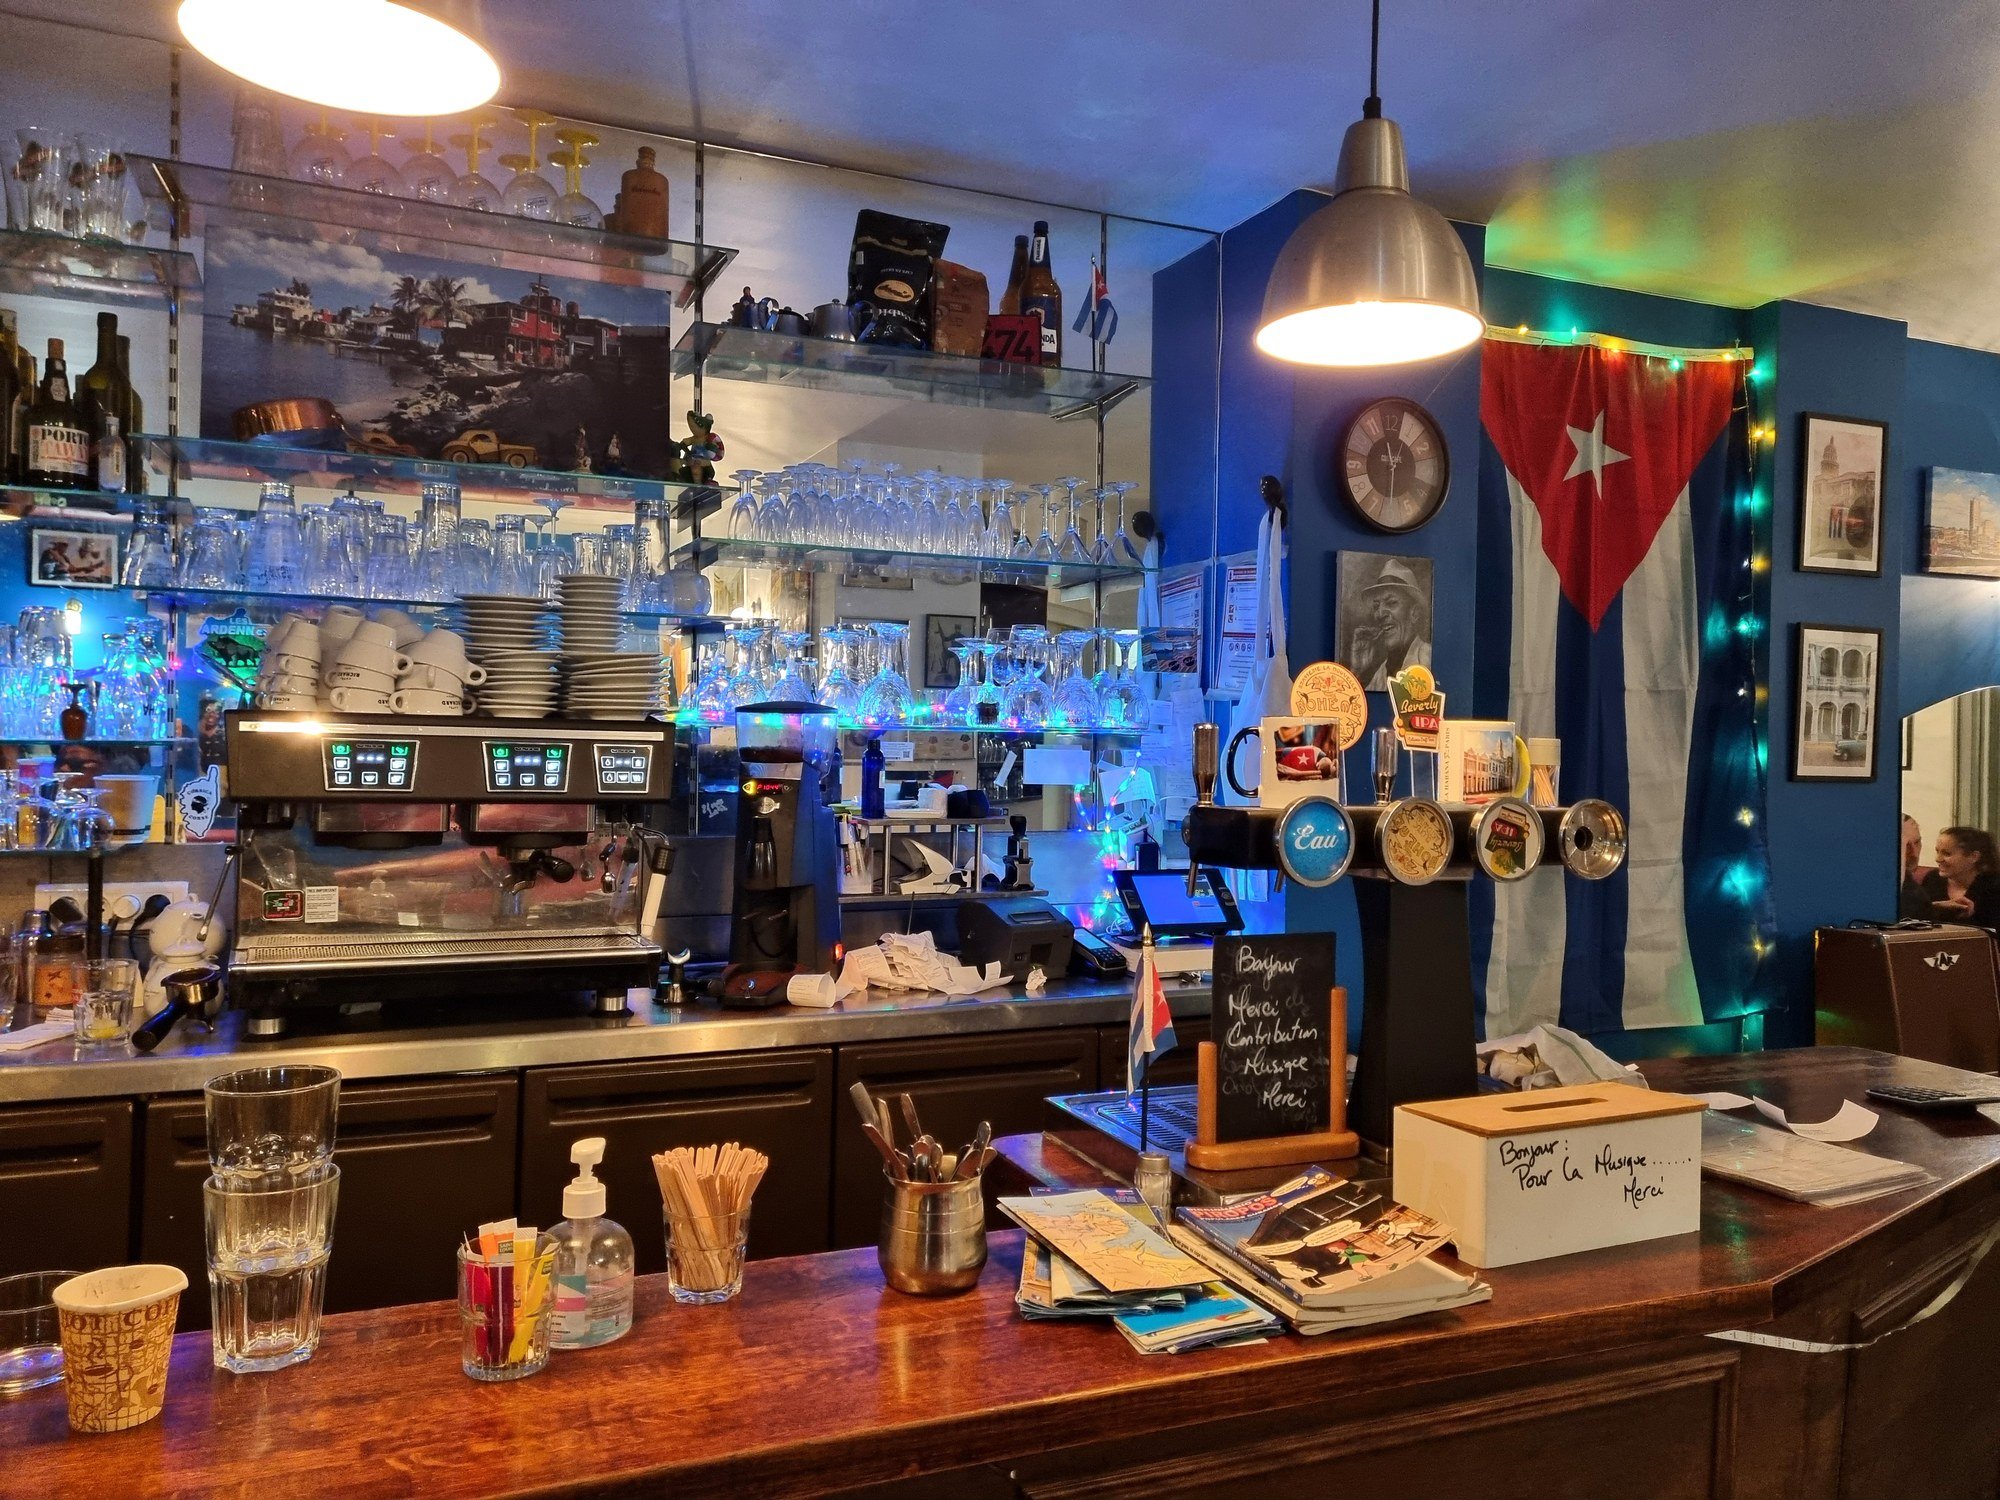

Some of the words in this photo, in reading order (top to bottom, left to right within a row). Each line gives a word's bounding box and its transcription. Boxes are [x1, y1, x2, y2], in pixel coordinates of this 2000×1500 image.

[981, 329, 1035, 362] 74
[1366, 417, 1380, 436] 11
[1385, 415, 1398, 432] 12
[1416, 441, 1430, 455] 2
[1352, 481, 1366, 494] 8
[1400, 695, 1439, 715] Beverly
[1415, 716, 1438, 728] IPA
[1294, 824, 1338, 850] Eau
[1495, 822, 1515, 837] IPA
[1239, 945, 1302, 992] Bonjour
[1228, 983, 1279, 1025] Merci
[1243, 1047, 1309, 1080] Musique
[1263, 1081, 1307, 1112] Merci
[1500, 1140, 1559, 1167] Bonjour
[1512, 1164, 1552, 1190] Pour
[1624, 1175, 1664, 1209] Merci
[1190, 1197, 1278, 1218] PIROPOS
